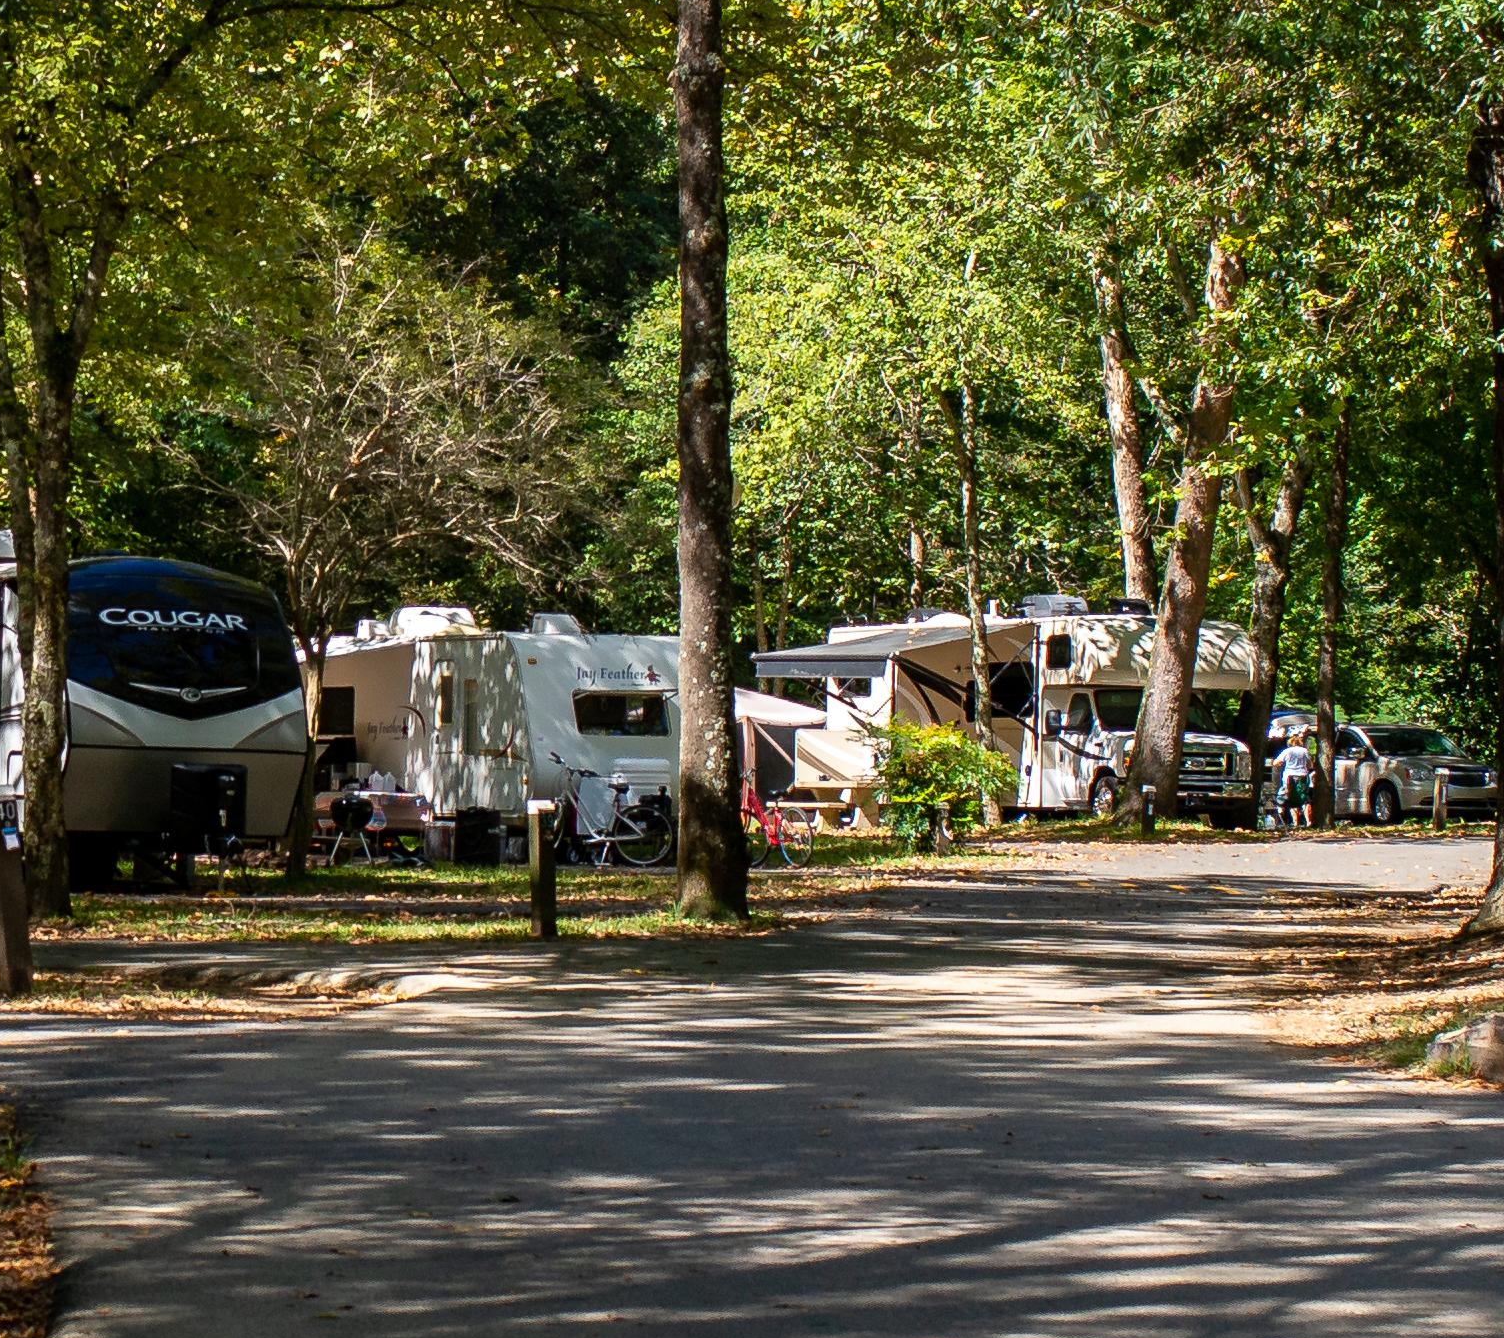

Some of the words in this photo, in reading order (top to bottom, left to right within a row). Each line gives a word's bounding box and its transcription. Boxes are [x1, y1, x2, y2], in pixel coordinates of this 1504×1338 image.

[98, 608, 249, 631] COUGAR
[577, 667, 597, 687] Jay
[600, 663, 645, 680] Feather
